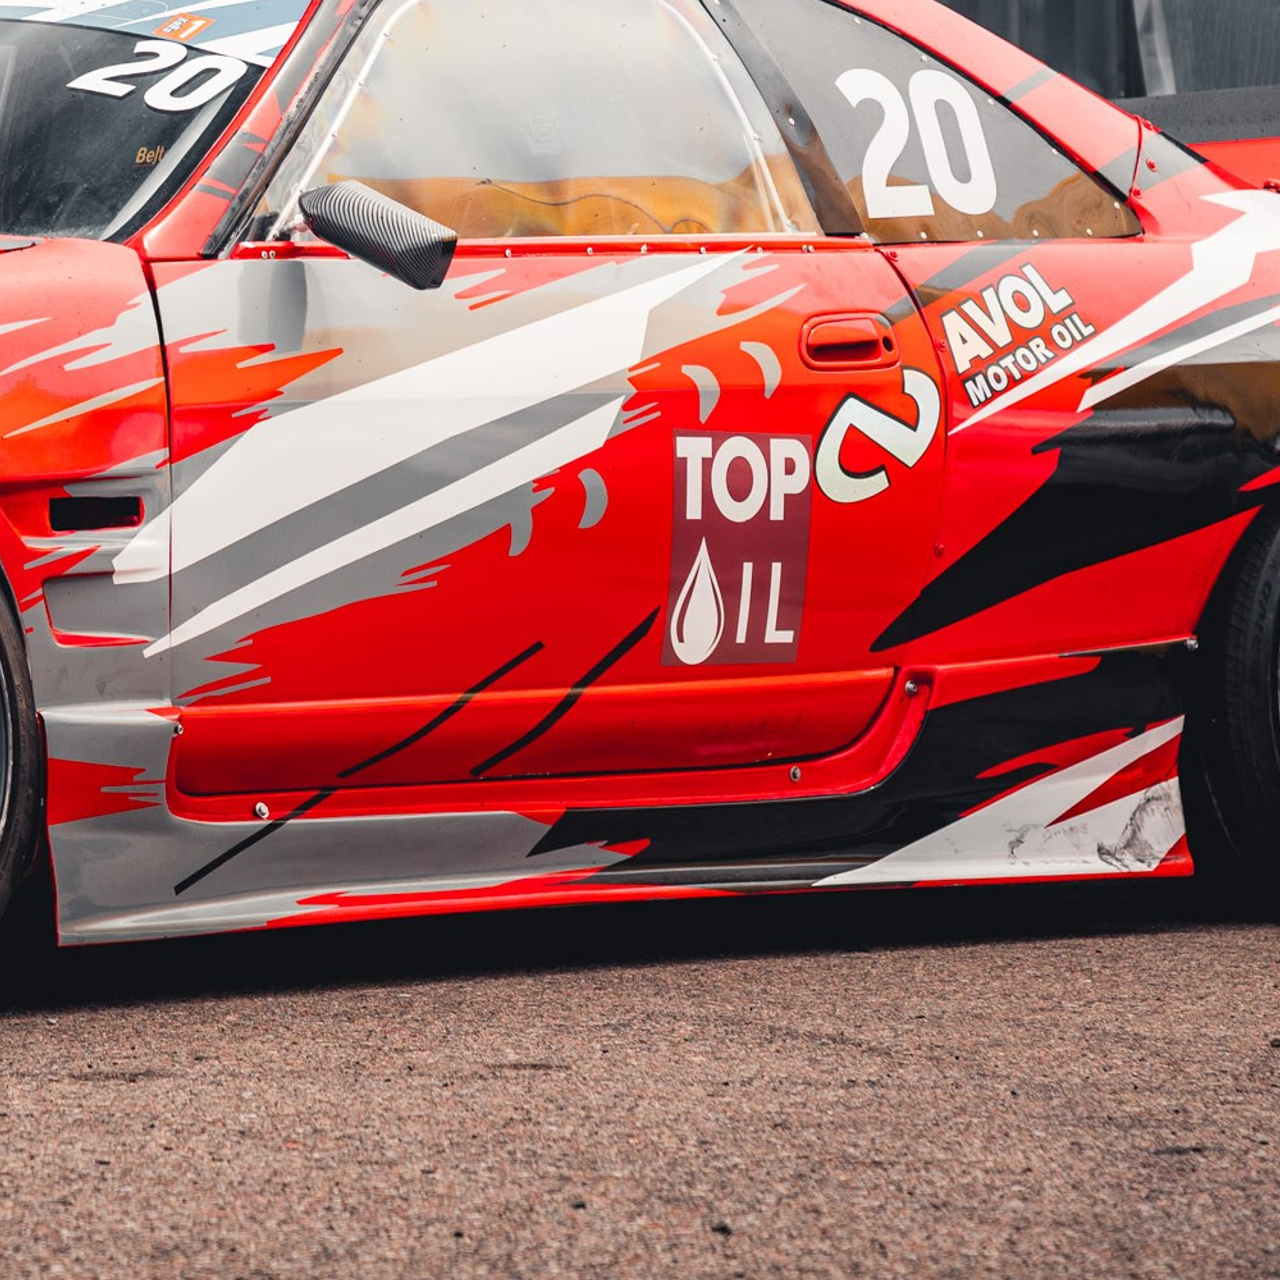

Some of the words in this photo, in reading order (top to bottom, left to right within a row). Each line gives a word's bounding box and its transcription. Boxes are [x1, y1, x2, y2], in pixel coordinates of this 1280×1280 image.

[65, 39, 249, 112] 20
[834, 67, 998, 219] 20
[940, 261, 1075, 375] AVOL
[962, 336, 1059, 408] MOTOR
[1049, 311, 1097, 351] OIL
[675, 435, 811, 523] TOP
